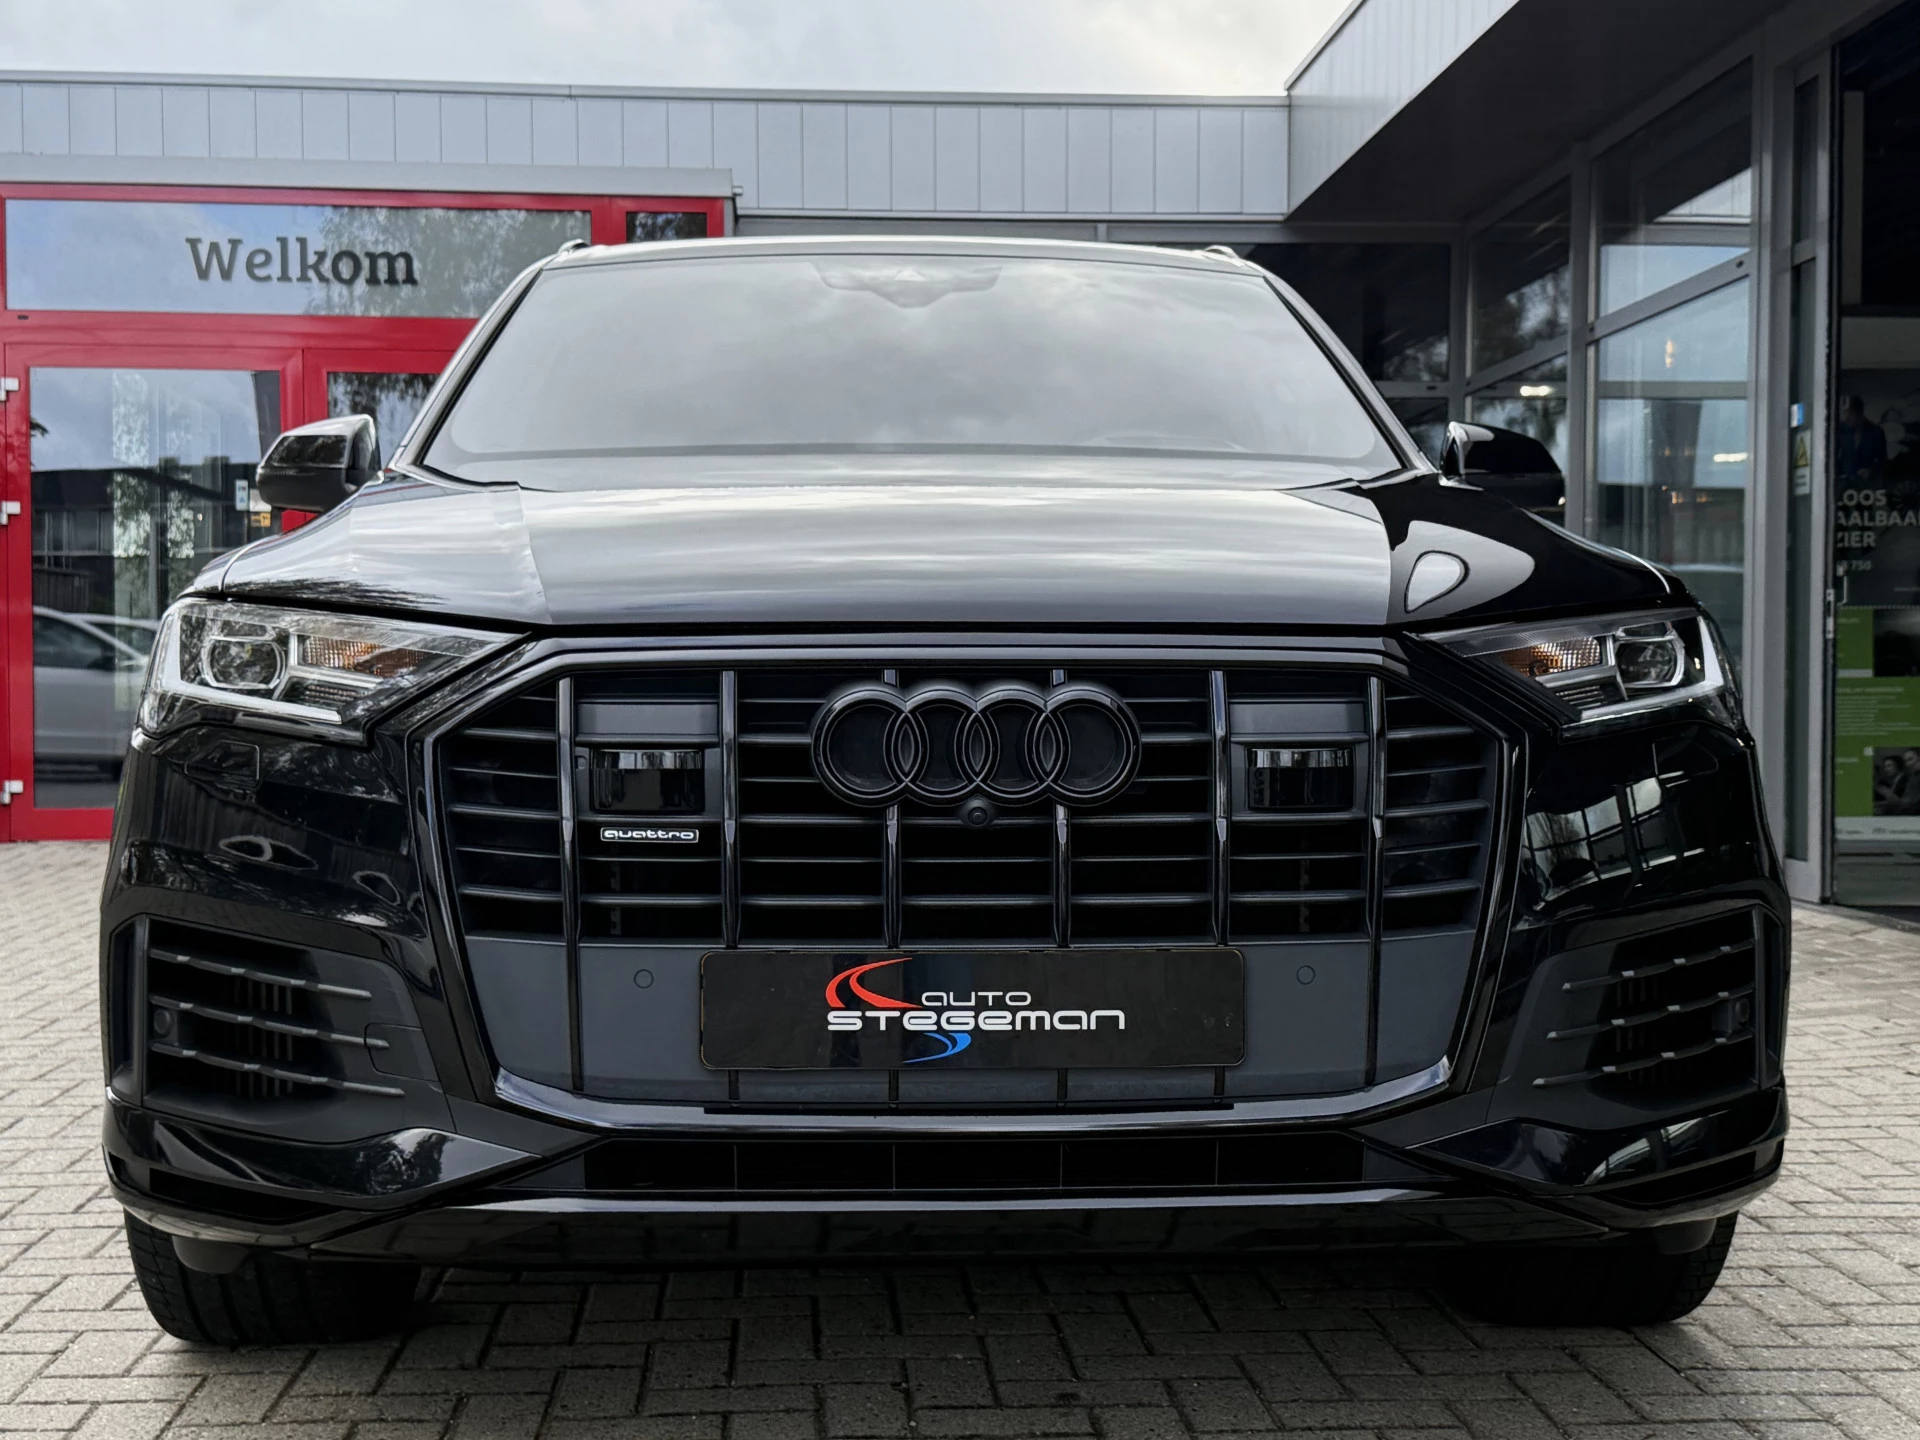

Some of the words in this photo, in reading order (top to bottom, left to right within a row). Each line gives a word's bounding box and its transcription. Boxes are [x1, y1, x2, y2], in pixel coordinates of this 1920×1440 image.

[185, 236, 418, 286] Welkom
[1837, 509, 1920, 526] AALBAA
[604, 830, 694, 839] quattro
